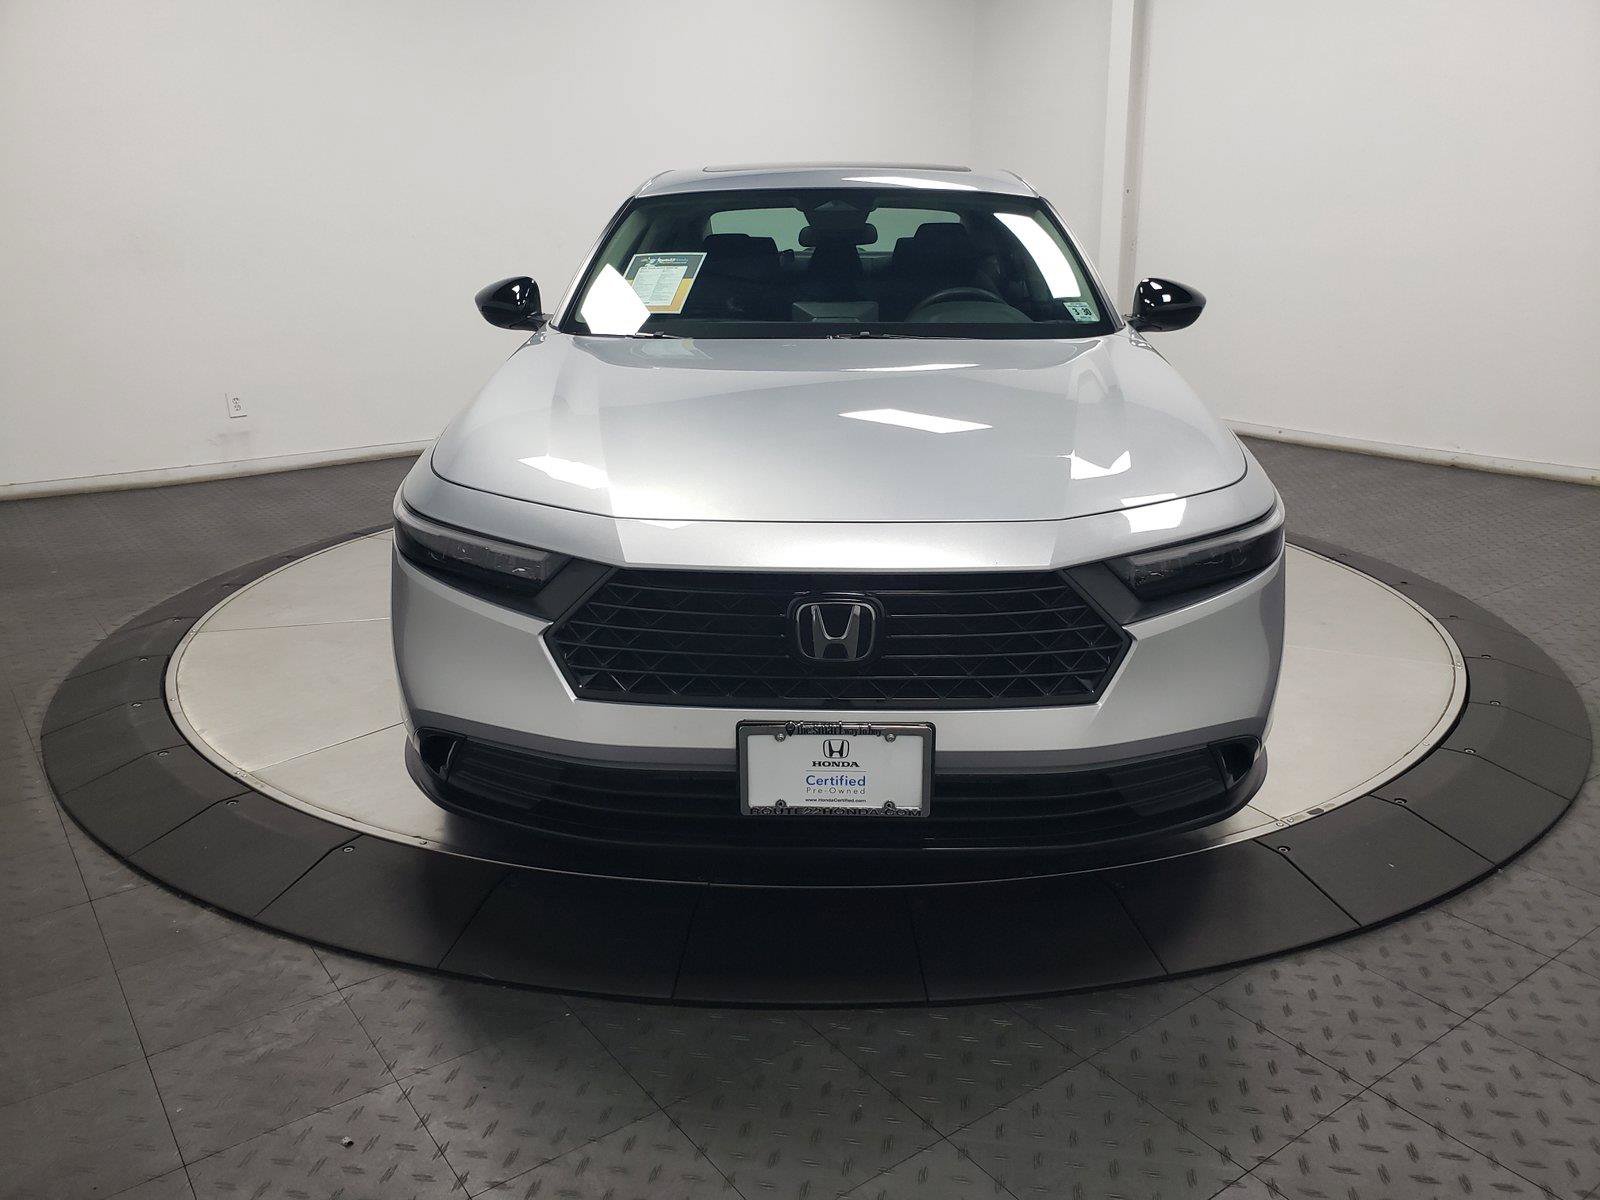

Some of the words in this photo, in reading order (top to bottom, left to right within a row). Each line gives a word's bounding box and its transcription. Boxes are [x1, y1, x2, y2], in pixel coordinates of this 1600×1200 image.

[811, 760, 860, 768] HONDA
[805, 774, 866, 787] Certified
[806, 786, 866, 795] Pre-Owned
